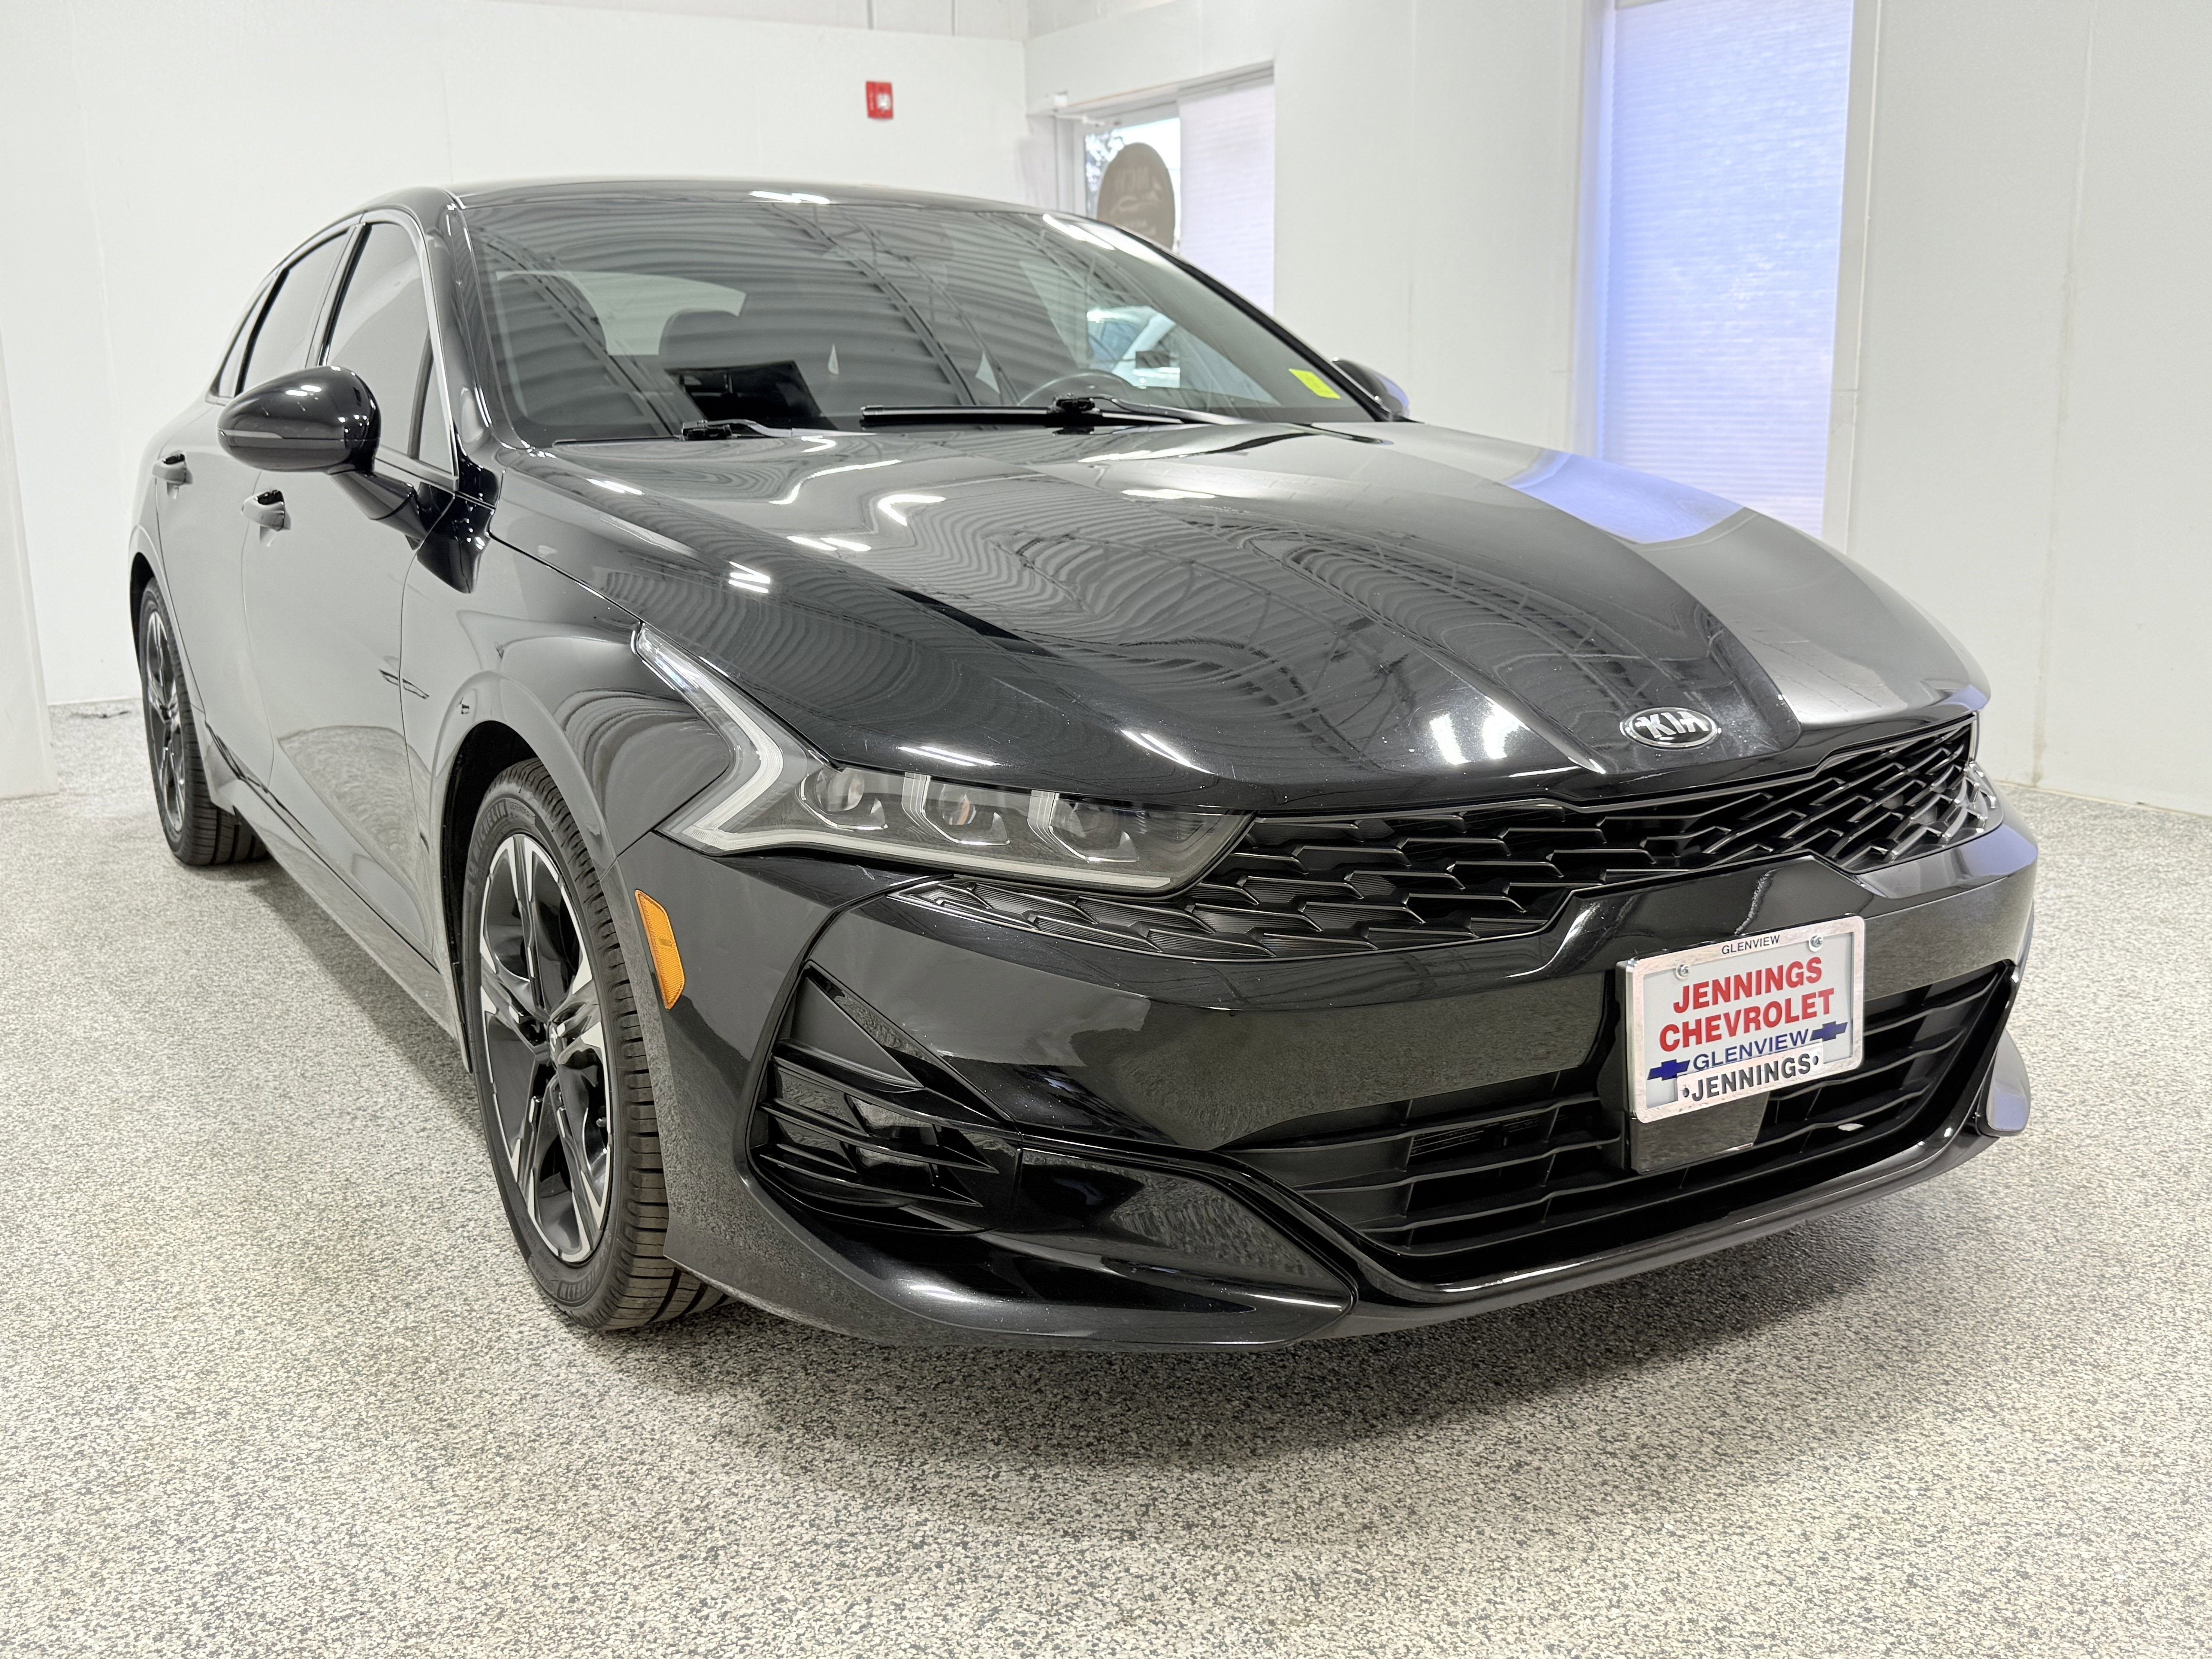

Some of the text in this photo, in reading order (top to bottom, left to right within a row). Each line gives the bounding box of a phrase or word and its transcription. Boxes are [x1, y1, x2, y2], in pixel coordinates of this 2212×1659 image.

[1635, 711, 1709, 738] KIA
[1722, 934, 1780, 955] GLENVIEW
[1673, 957, 1822, 1013] JENNINGS
[1659, 988, 1834, 1052] CHEVROLET
[1693, 1029, 1809, 1071] GLENVIEW
[1691, 1053, 1811, 1102] JENNINGS
